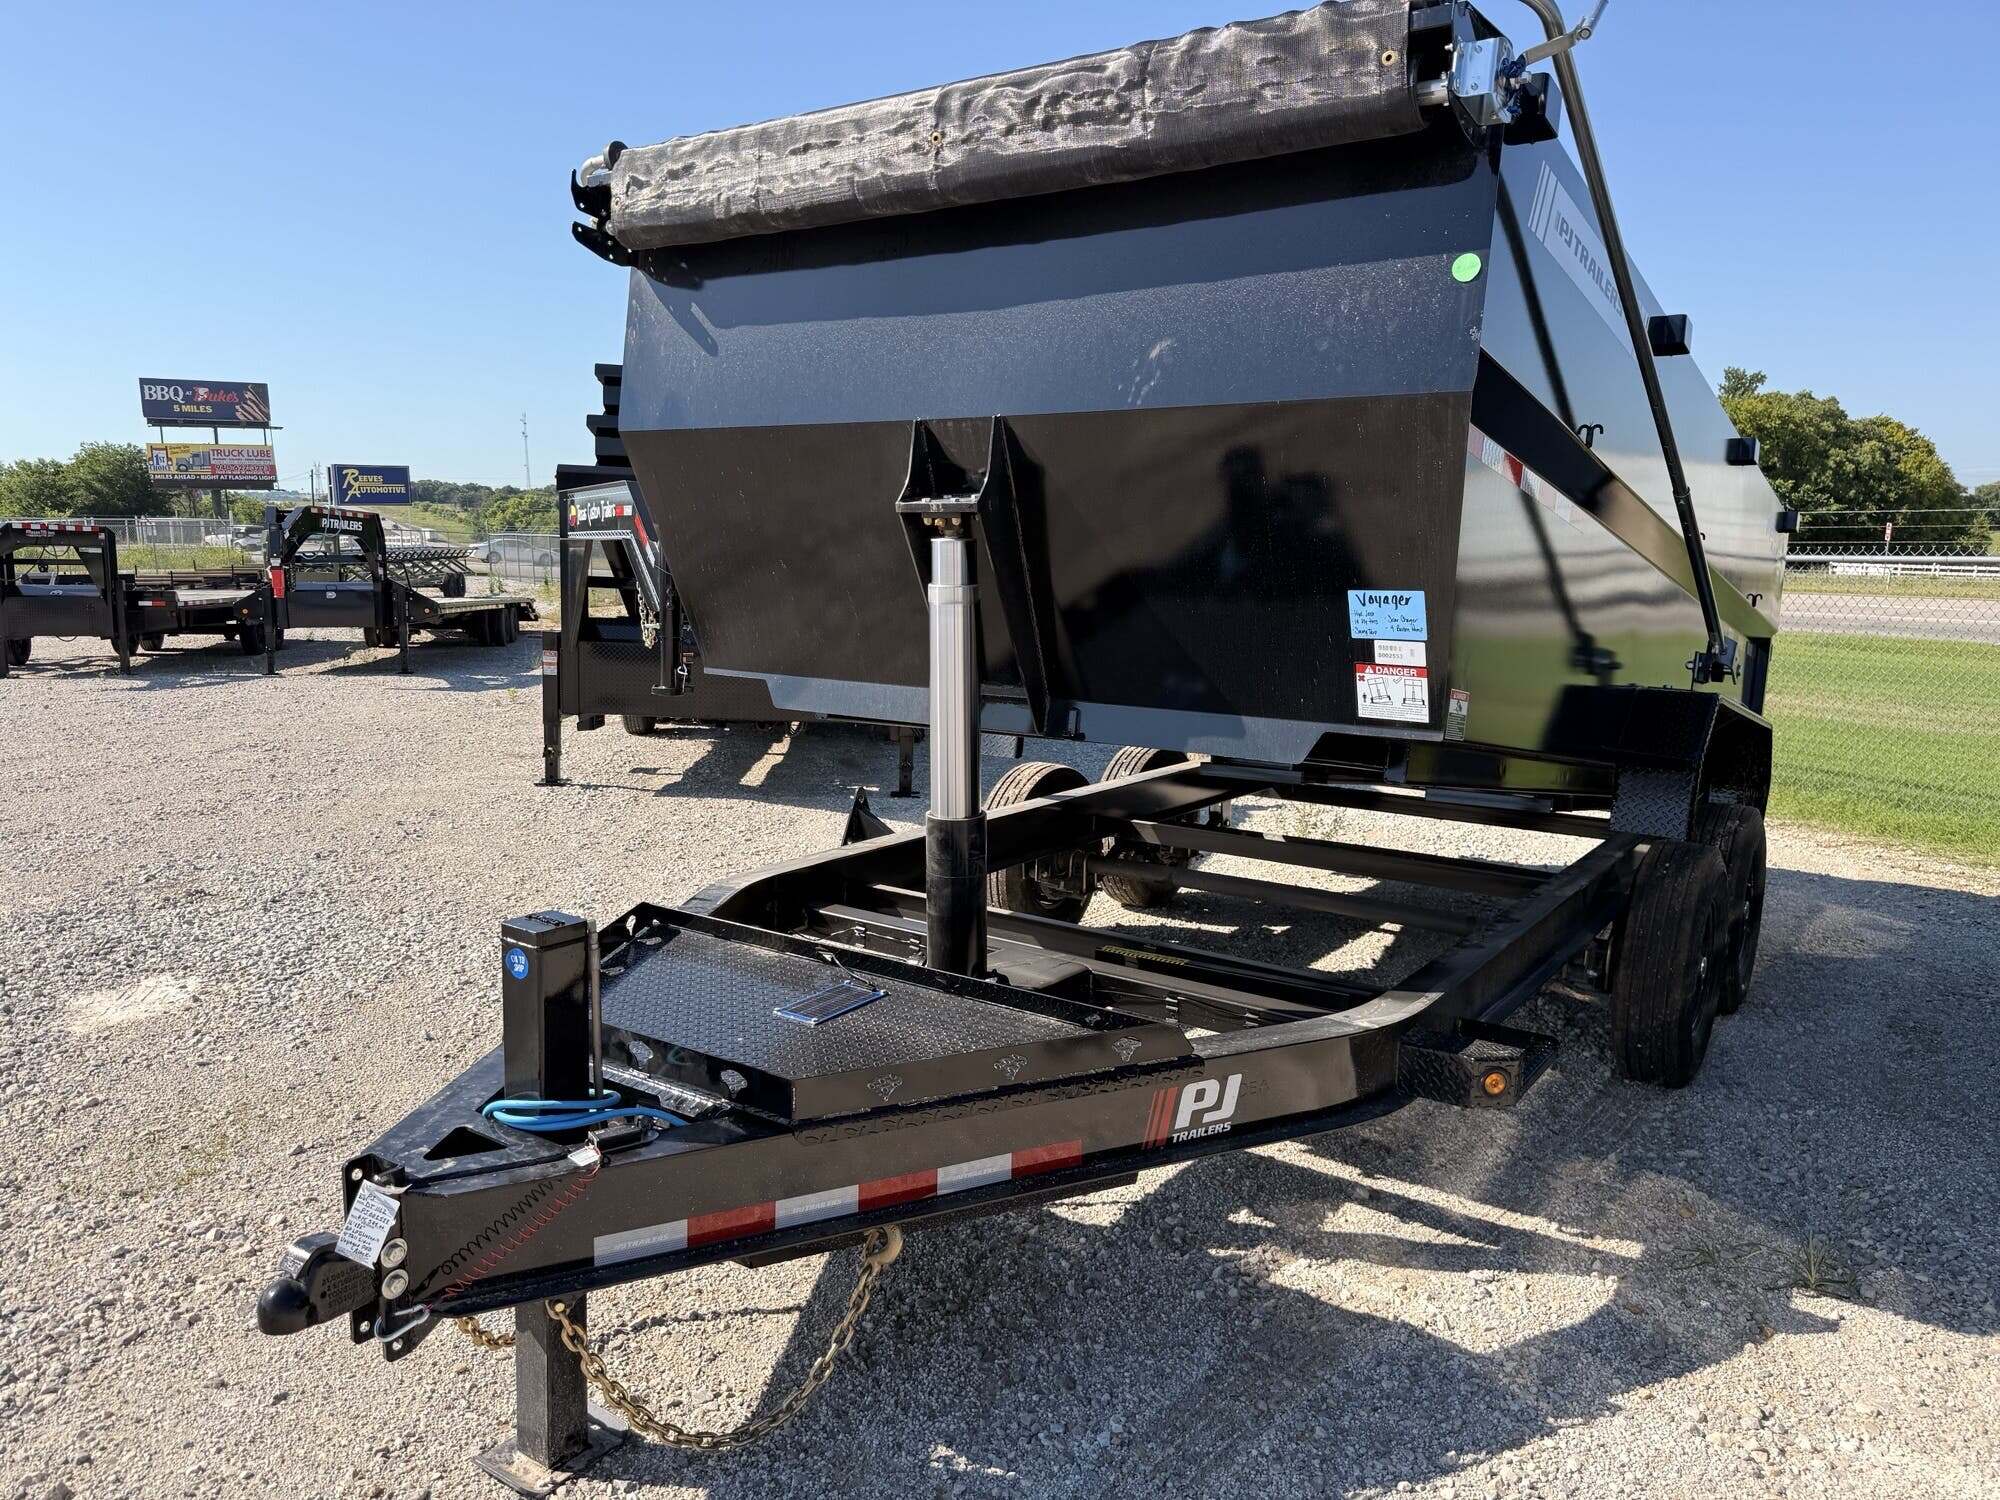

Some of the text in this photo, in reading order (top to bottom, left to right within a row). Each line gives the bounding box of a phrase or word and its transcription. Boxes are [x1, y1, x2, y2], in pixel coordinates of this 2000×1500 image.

[143, 384, 185, 403] BBQ
[173, 404, 213, 413] 5 MILES
[210, 448, 271, 458] TRUCK LUBE
[342, 468, 383, 489] REEVES
[344, 481, 406, 502] AUTOMOTIVE
[1355, 591, 1412, 611] Voyager
[1375, 666, 1417, 677] DANGER
[1174, 1073, 1243, 1130] PJ
[1171, 1121, 1232, 1143] TRAILERS
